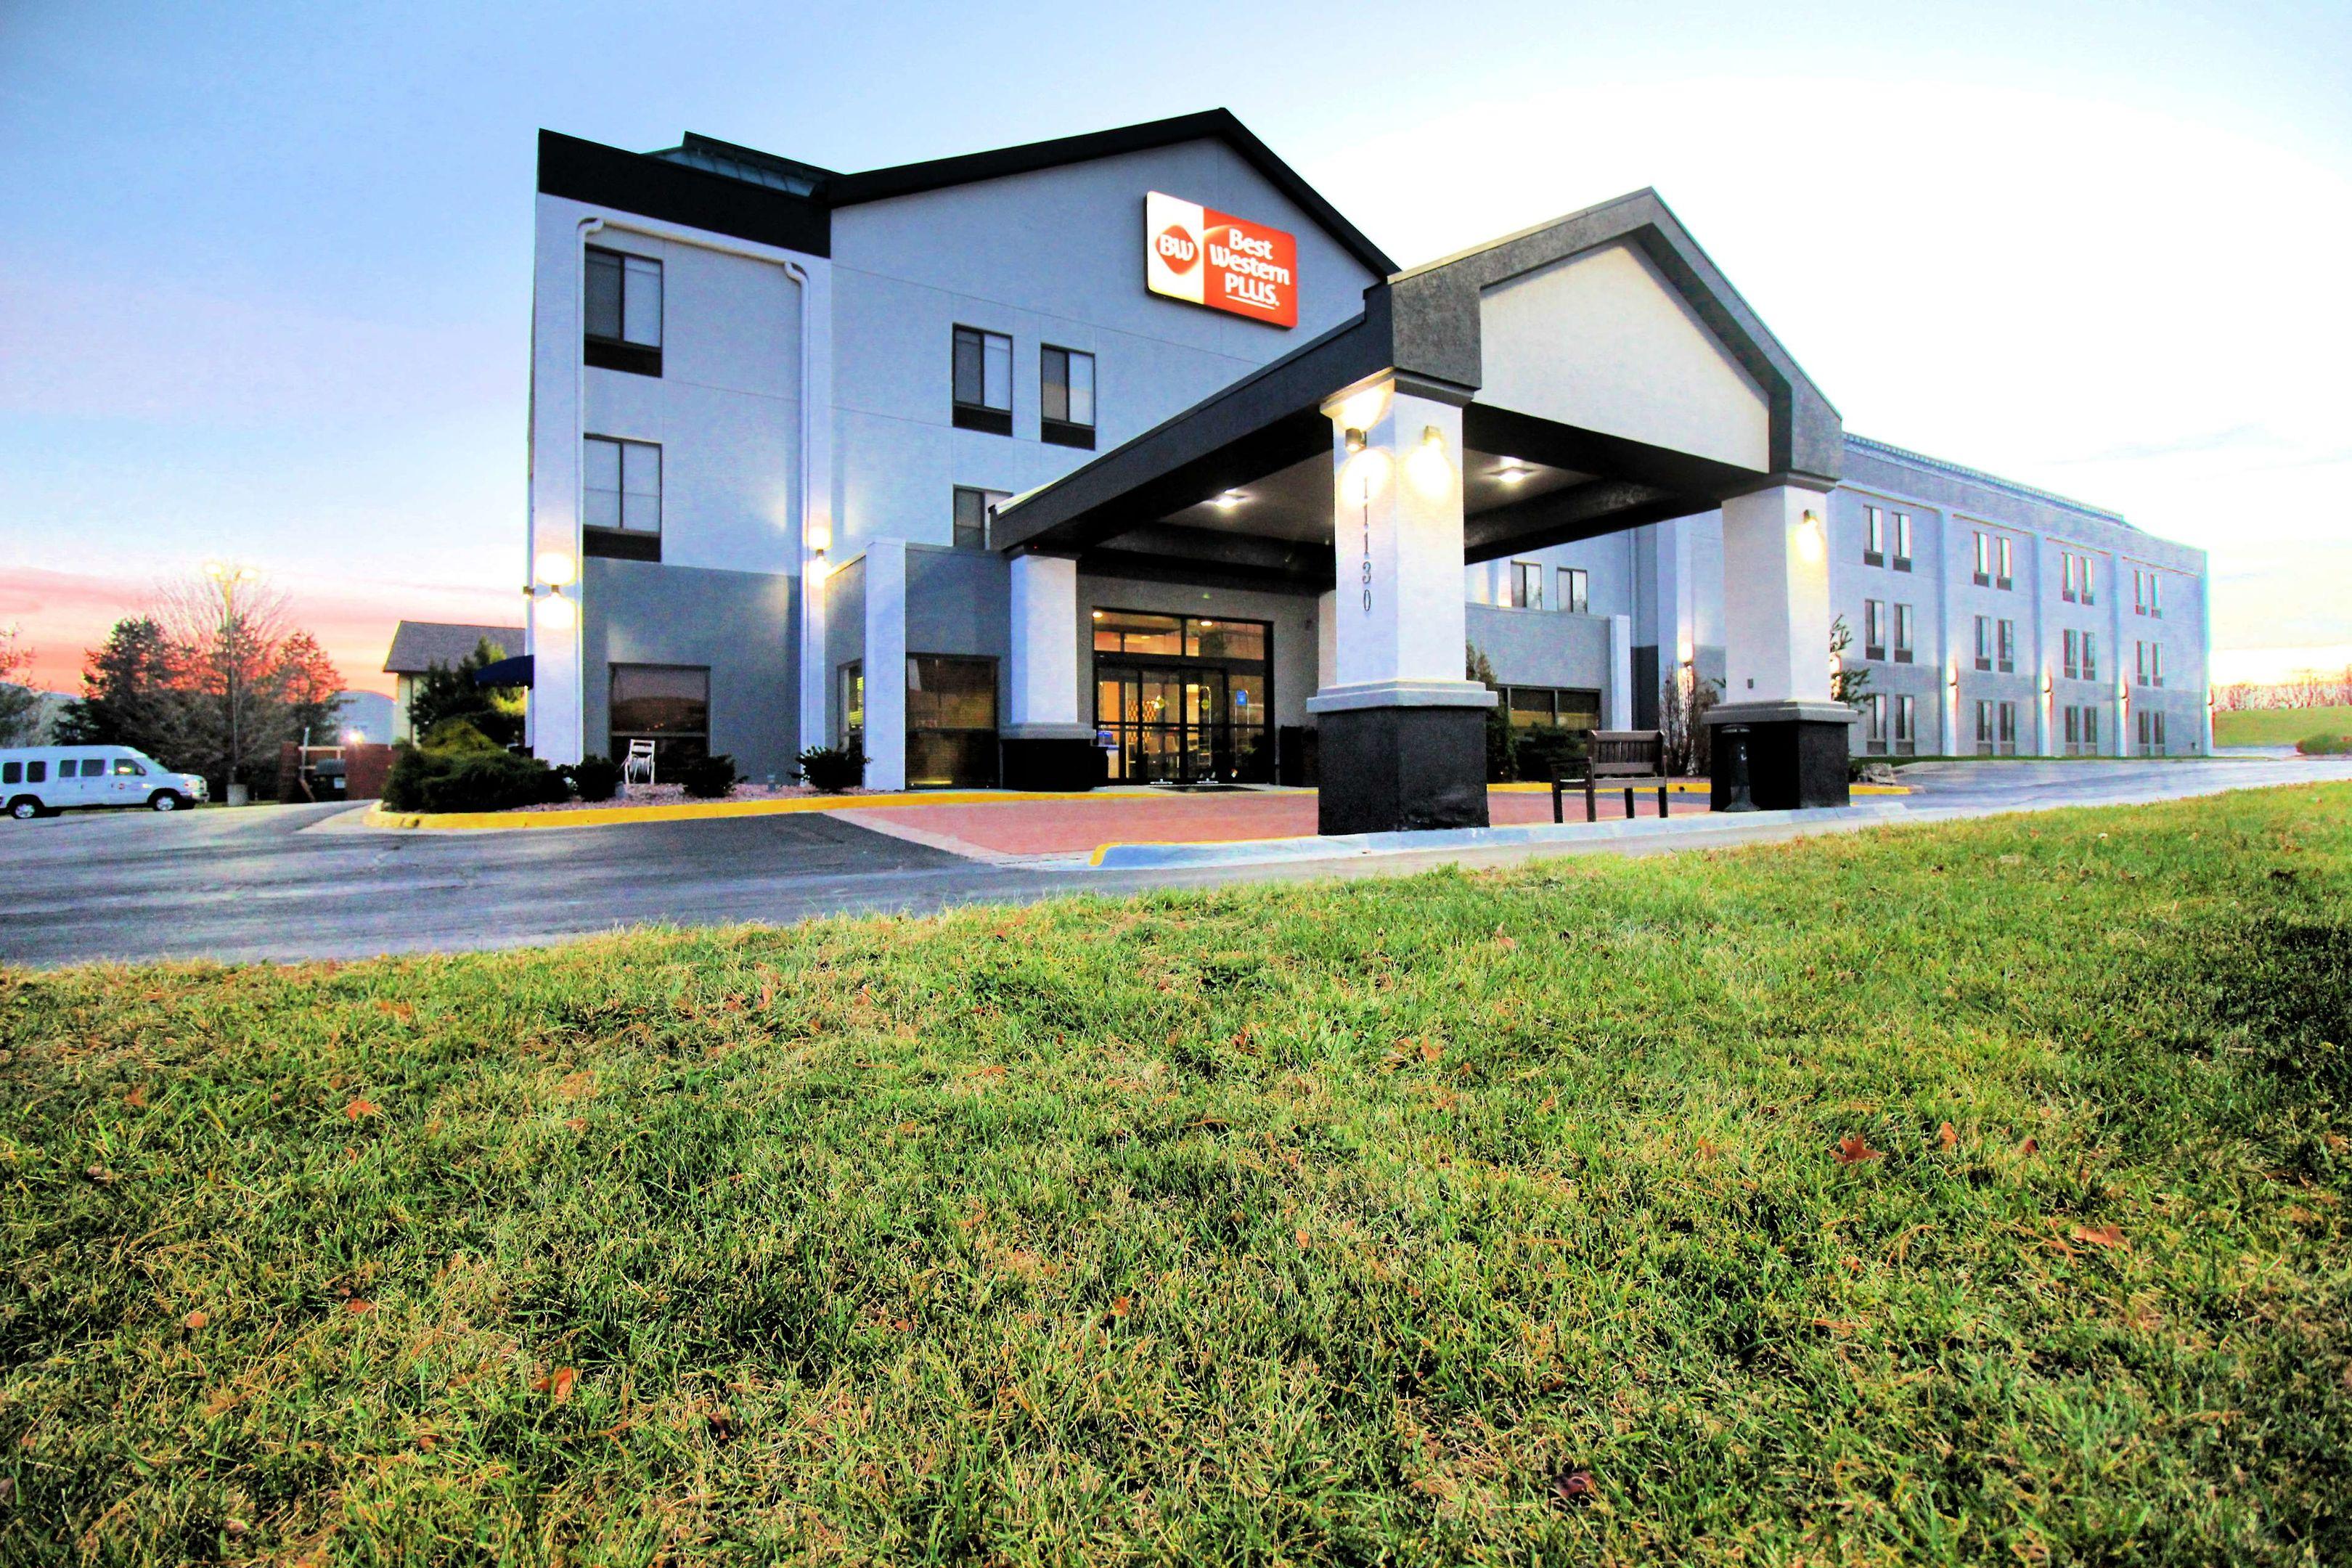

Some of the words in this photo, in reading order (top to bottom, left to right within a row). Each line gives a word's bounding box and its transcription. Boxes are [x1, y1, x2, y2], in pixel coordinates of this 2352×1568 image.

[1160, 234, 1194, 261] BW
[1230, 229, 1273, 260] Best
[1209, 244, 1290, 285] Western
[1362, 476, 1371, 611] 11130
